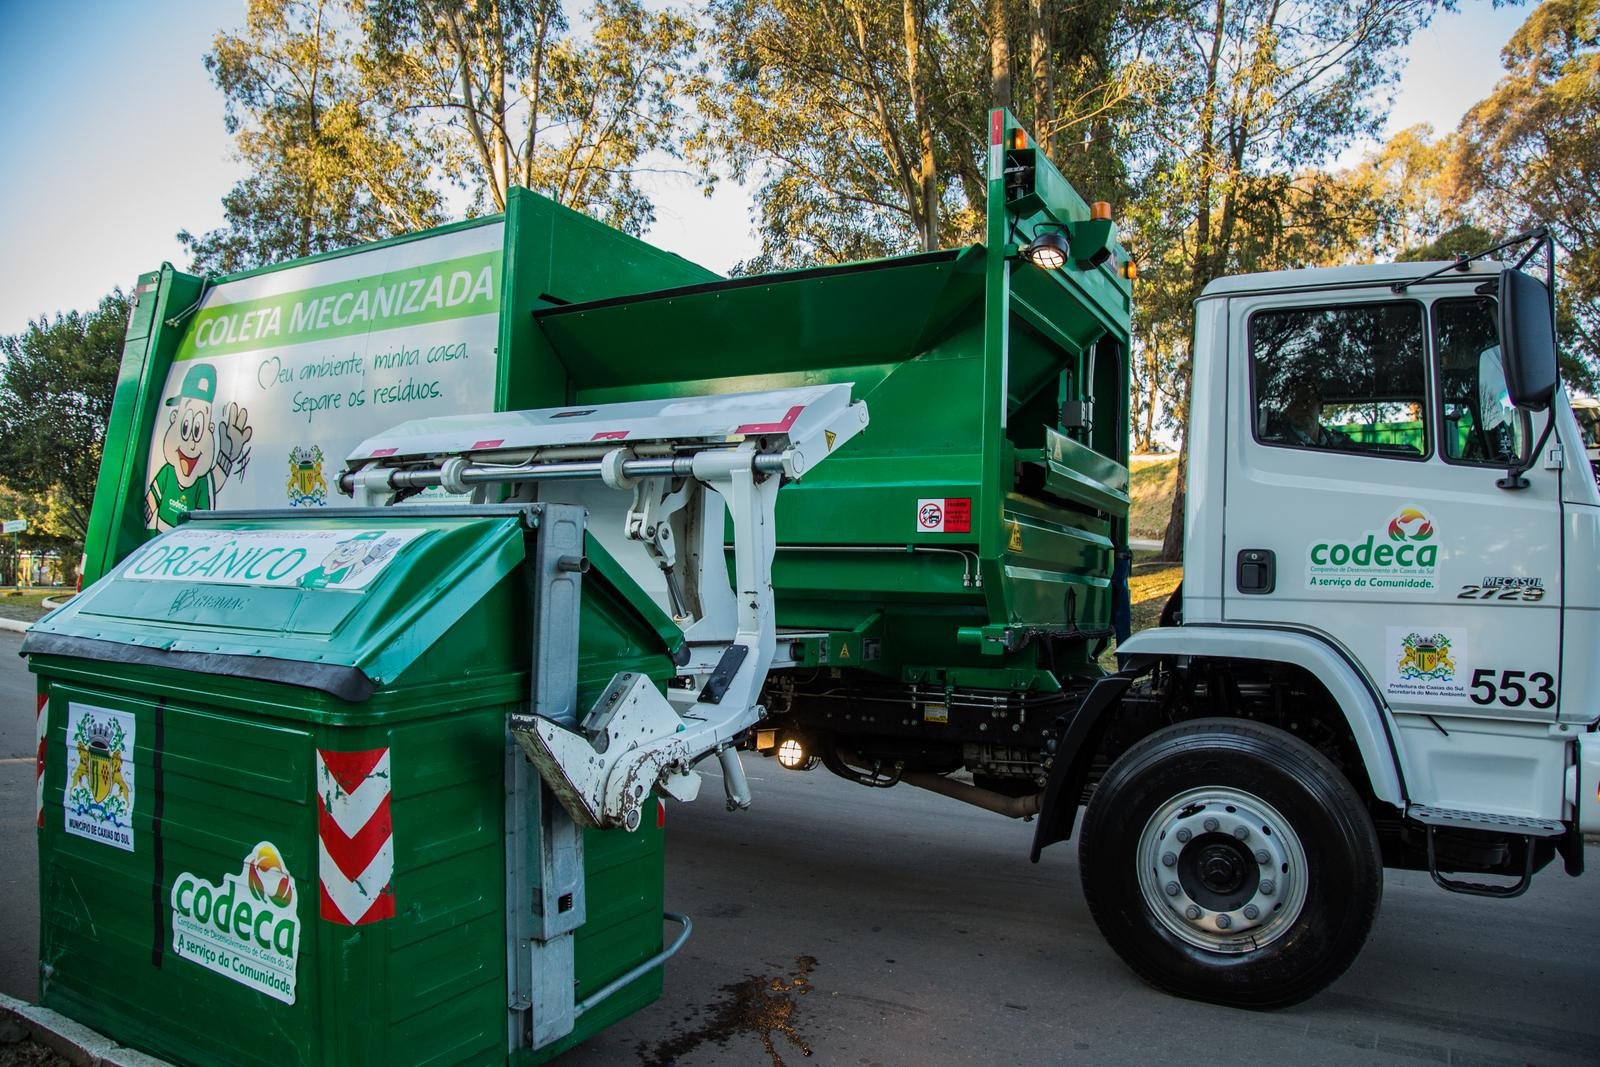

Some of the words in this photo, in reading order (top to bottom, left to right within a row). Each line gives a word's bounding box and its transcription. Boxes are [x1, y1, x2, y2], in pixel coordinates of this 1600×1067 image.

[195, 306, 281, 348] COLETA
[288, 266, 493, 334] MECANIZADA
[299, 352, 366, 380] ambiente,
[373, 344, 420, 370] minha
[426, 342, 469, 364] casa.
[292, 391, 342, 424] Separe
[348, 389, 366, 407] os
[373, 377, 443, 405] resíduos.
[134, 540, 308, 581] ORGÂNICO
[1310, 534, 1438, 567] codeca
[1309, 576, 1317, 586] A
[1319, 577, 1352, 588] serviço
[1354, 577, 1366, 587] da
[1369, 577, 1435, 588] Comunidade.
[1457, 585, 1546, 602] 2729
[1482, 576, 1544, 588] MECASUL
[1387, 688, 1416, 696] Secretaria
[1439, 690, 1467, 698] Ambiente
[1469, 669, 1557, 709] 553
[91, 825, 97, 836] DE
[98, 827, 114, 840] CAXIAS
[114, 831, 120, 842] DO
[121, 833, 130, 845] SUL
[176, 879, 295, 959] codeca
[177, 934, 185, 949] A
[185, 941, 216, 964] serviço
[218, 951, 230, 969] da
[232, 957, 293, 996] Comunidade.
